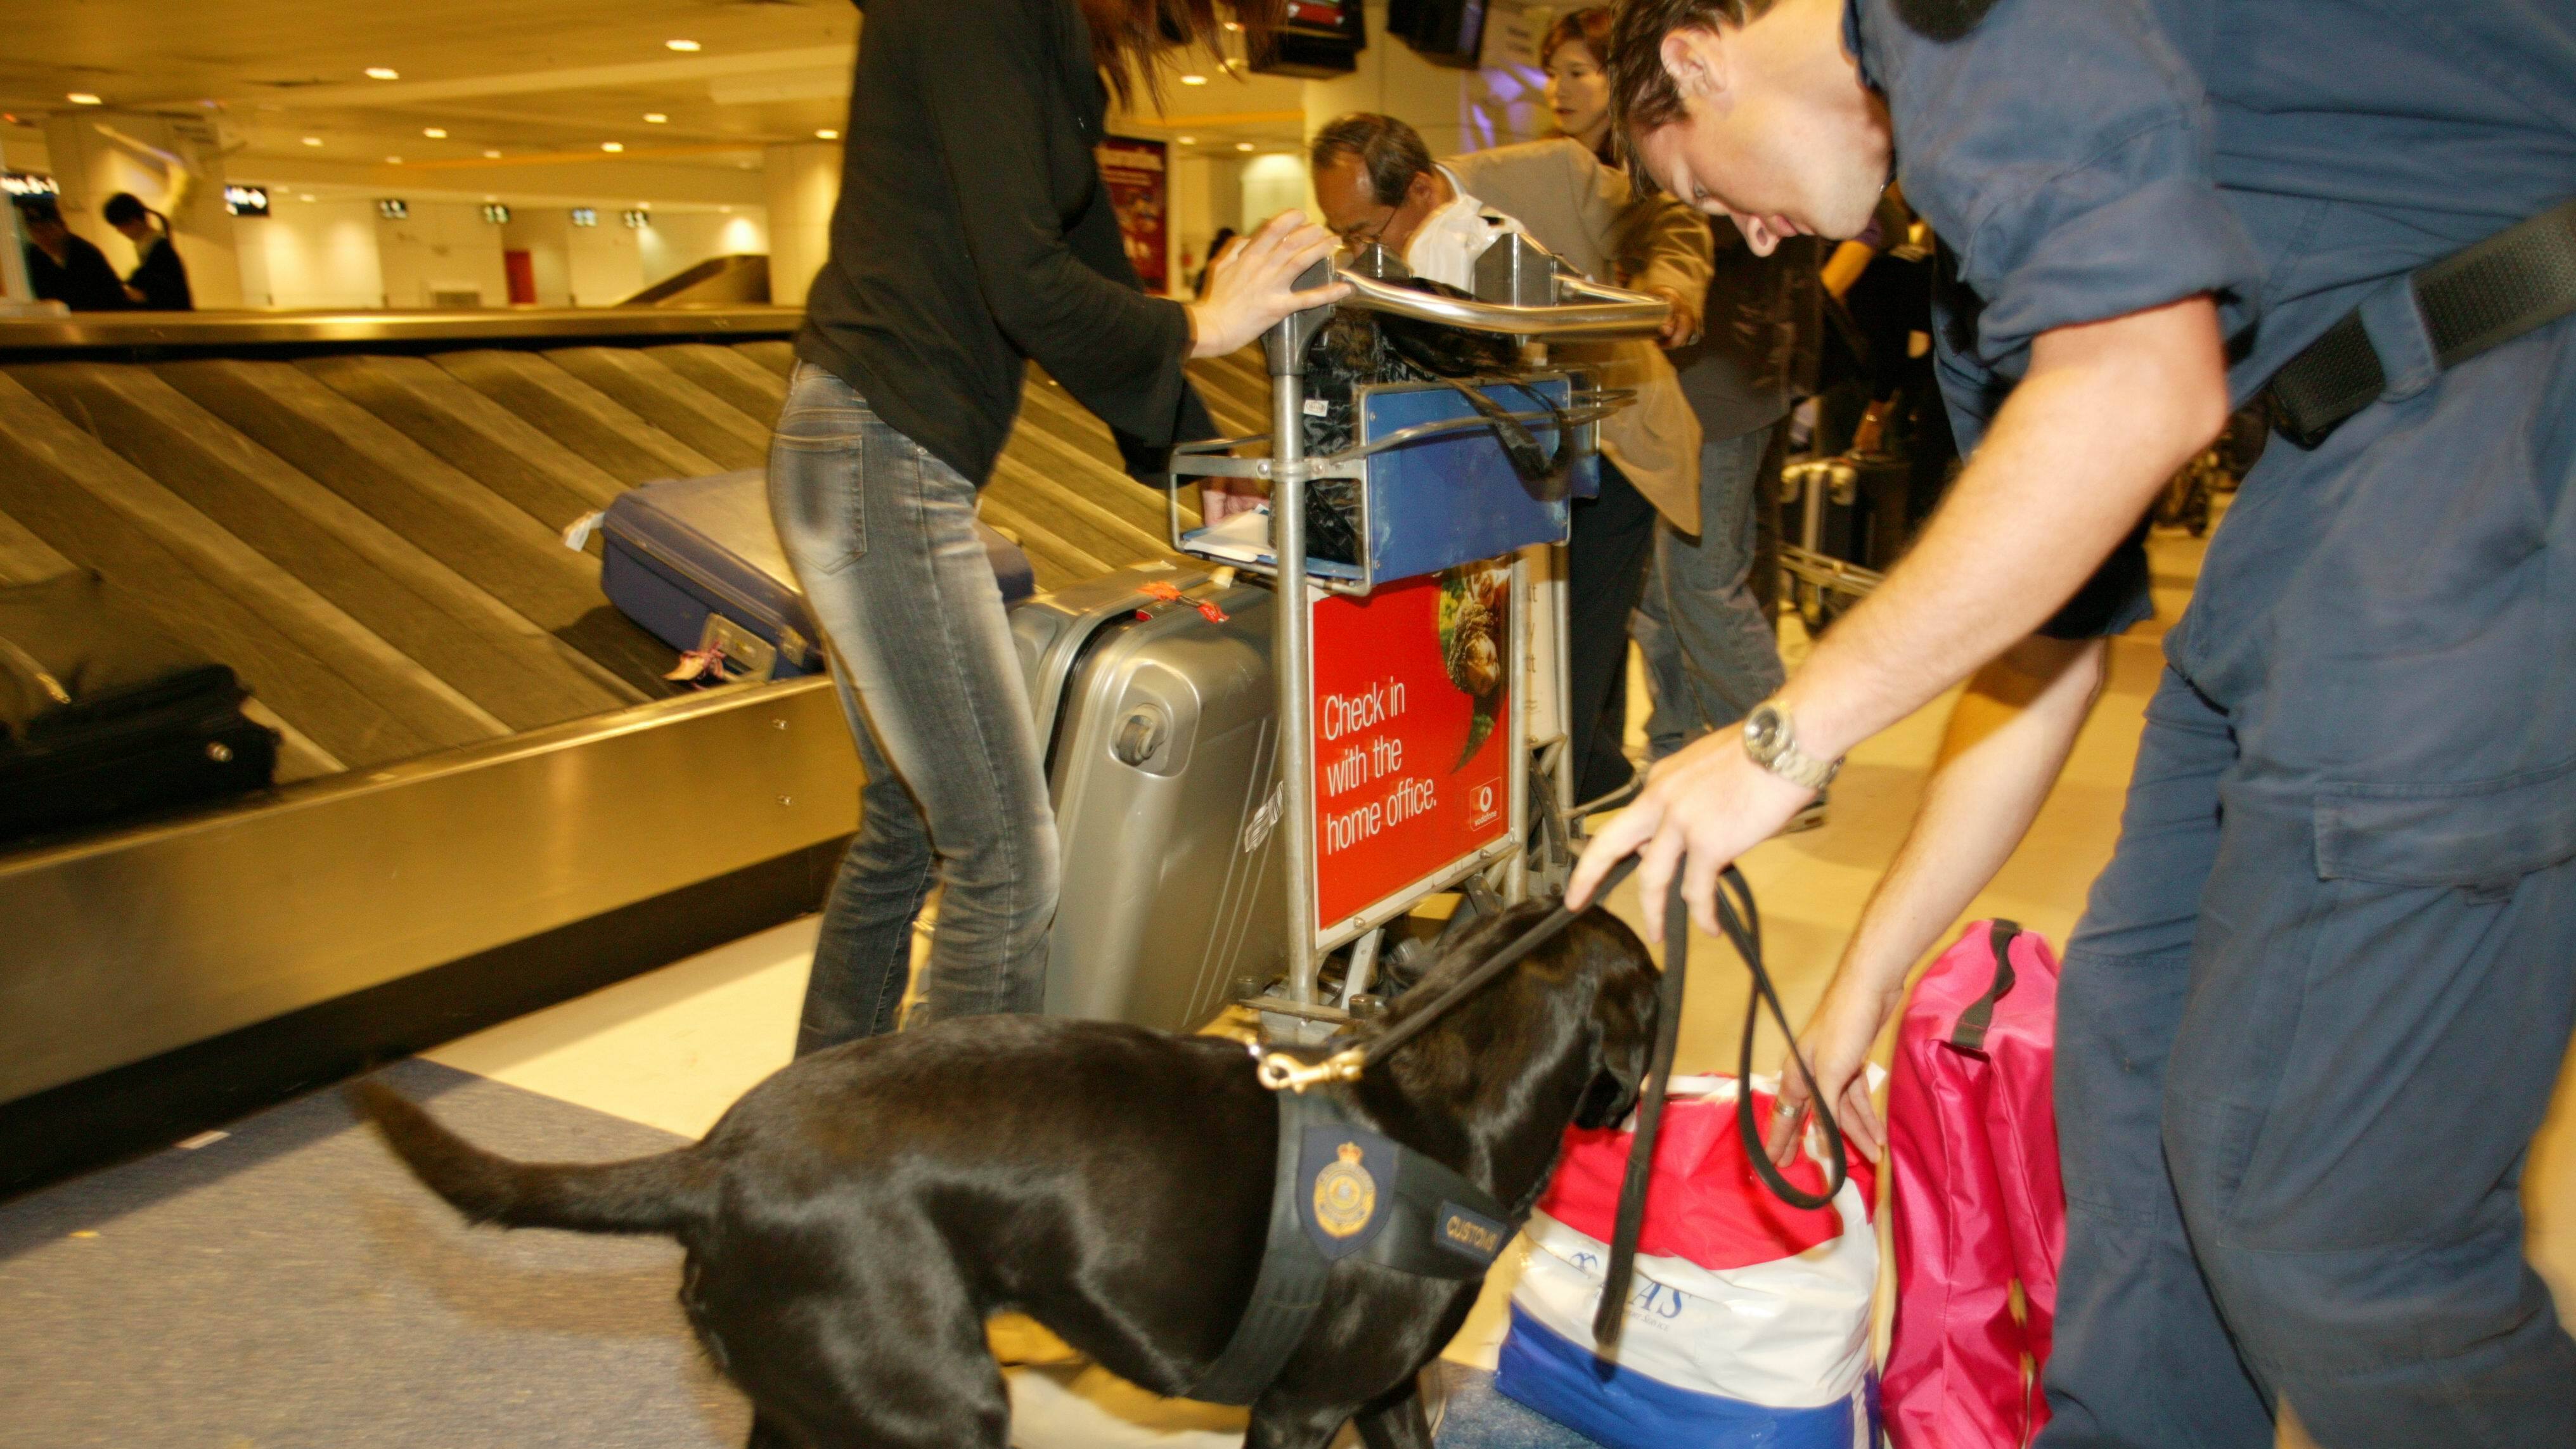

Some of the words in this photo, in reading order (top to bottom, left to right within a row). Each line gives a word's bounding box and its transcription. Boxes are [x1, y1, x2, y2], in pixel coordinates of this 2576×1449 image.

[1324, 681, 1385, 740] Check
[1390, 676, 1405, 718] in
[1327, 745, 1367, 797] with
[1372, 735, 1402, 778] the
[1327, 802, 1381, 855] home
[1387, 776, 1437, 827] office.
[1474, 810, 1497, 827] vodafone
[1446, 1215, 1498, 1252] CUSTOMS
